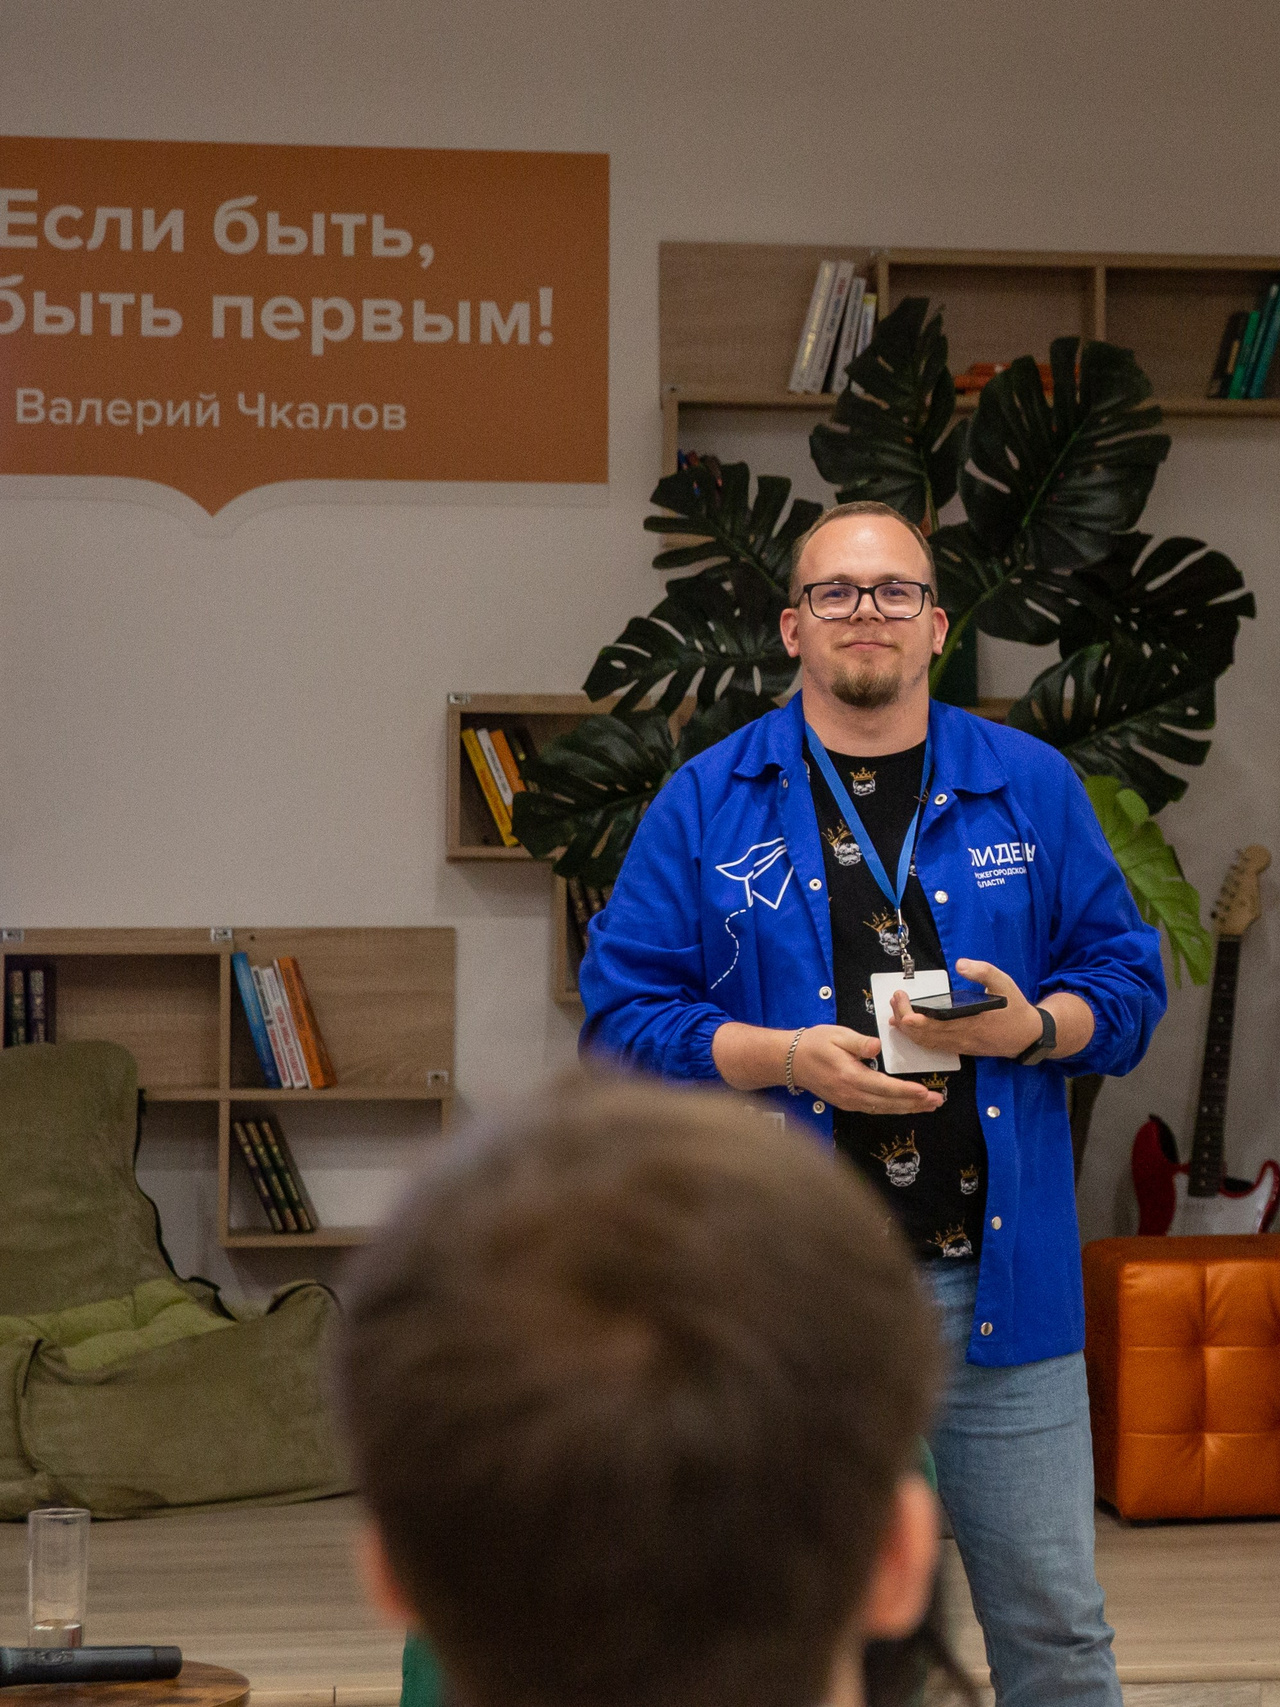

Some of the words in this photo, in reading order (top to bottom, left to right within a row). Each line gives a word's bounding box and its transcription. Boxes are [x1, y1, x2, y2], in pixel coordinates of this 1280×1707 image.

[0, 188, 186, 253] Если
[212, 195, 436, 270] быть,
[0, 274, 184, 338] быть
[211, 287, 554, 356] первым!
[15, 388, 221, 435] Валерий
[237, 392, 408, 431] Чкалов
[967, 842, 1036, 867] ЛИДЕЫ
